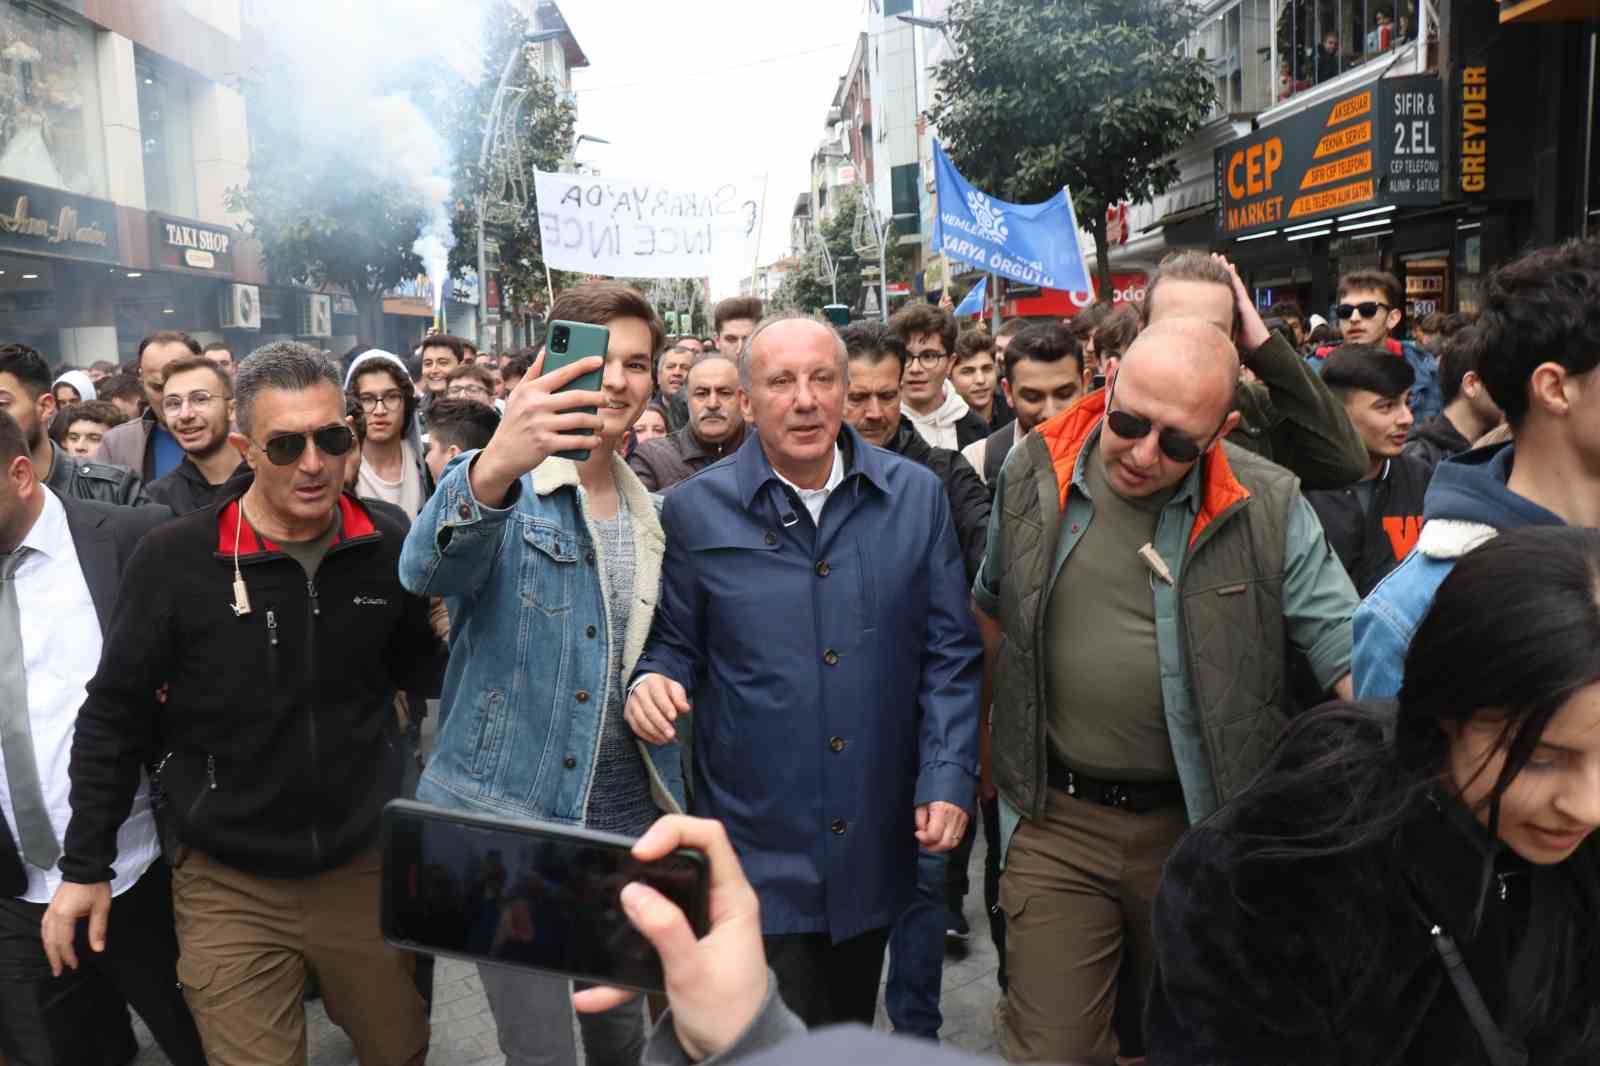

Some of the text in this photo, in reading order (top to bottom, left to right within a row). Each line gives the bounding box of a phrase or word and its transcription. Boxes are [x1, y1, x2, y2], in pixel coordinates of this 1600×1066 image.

[1335, 95, 1368, 119] AKSESUAR
[1394, 93, 1435, 116] SIFIR &
[1393, 121, 1436, 154] 2.EL
[1462, 66, 1487, 192] GREYDER
[1228, 136, 1283, 199] CEP
[1390, 159, 1440, 173] CEP TELEFONU
[1227, 196, 1283, 231] MARKET
[166, 223, 229, 253] TAKI SHOP
